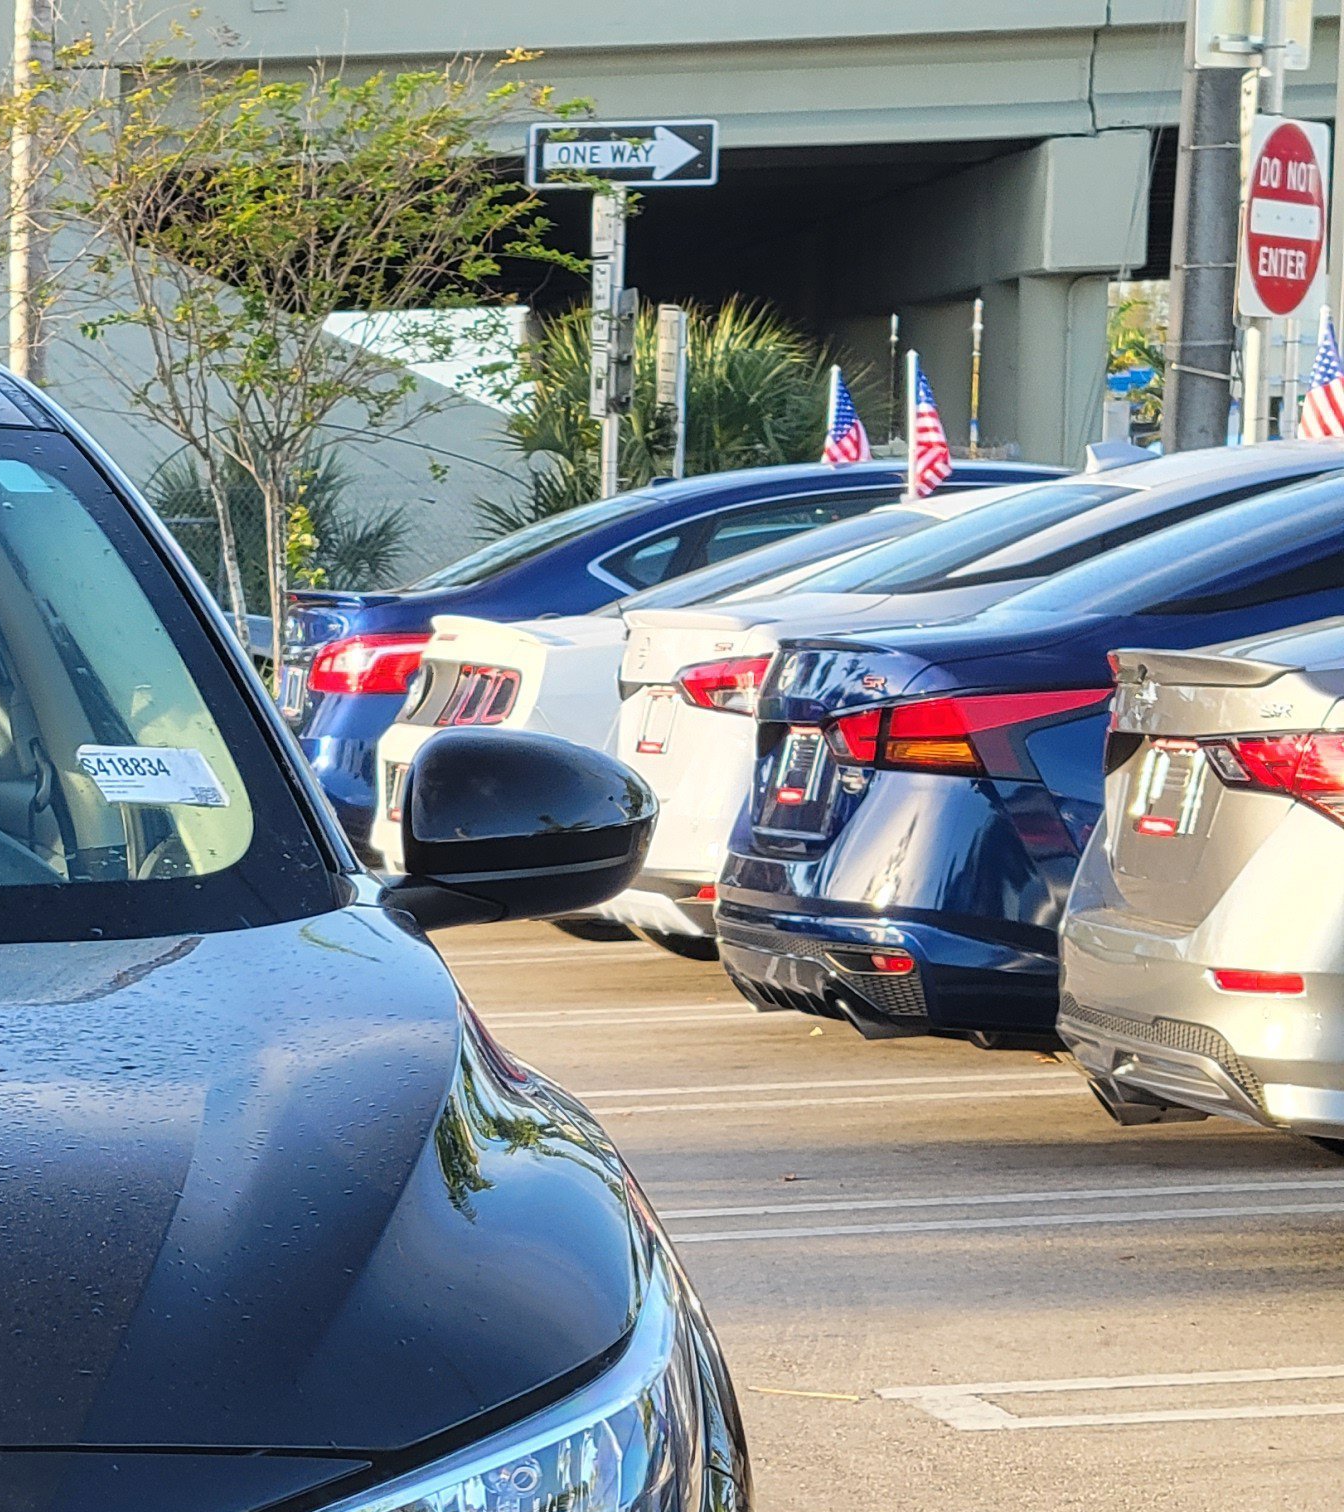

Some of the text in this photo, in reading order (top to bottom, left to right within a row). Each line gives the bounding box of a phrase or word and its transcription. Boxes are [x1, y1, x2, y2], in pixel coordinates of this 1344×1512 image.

[558, 144, 655, 164] ONE WAY
[1260, 157, 1315, 192] DO NOT
[1258, 247, 1306, 280] ENTER
[863, 675, 886, 690] SR
[80, 757, 171, 776] S418834
